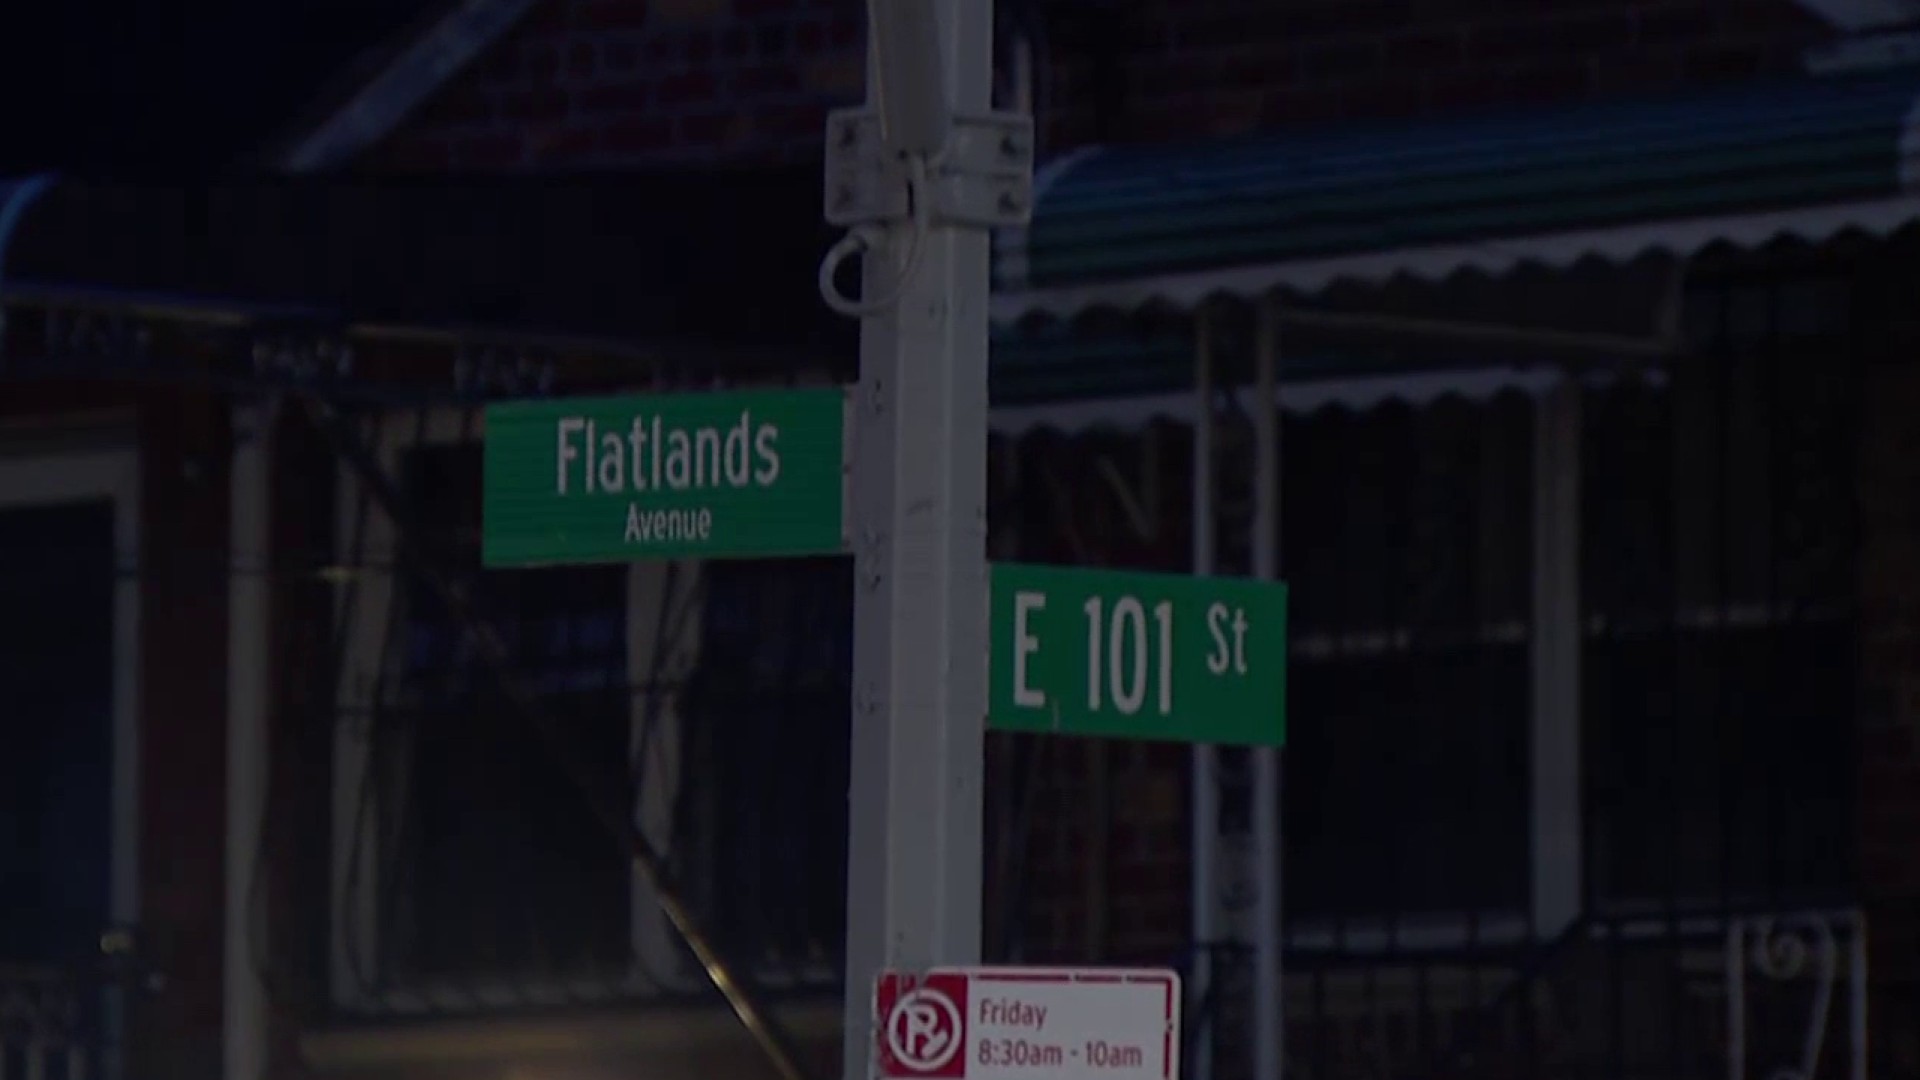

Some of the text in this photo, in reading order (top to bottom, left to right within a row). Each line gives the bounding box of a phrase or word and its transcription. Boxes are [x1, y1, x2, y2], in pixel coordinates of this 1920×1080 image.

[556, 408, 781, 496] Flatlands
[624, 502, 713, 544] Avenue
[1013, 590, 1249, 716] E 101 St
[979, 998, 1047, 1030] Friday
[978, 1039, 1063, 1066] 8:30am
[1085, 1041, 1143, 1067] 10am
